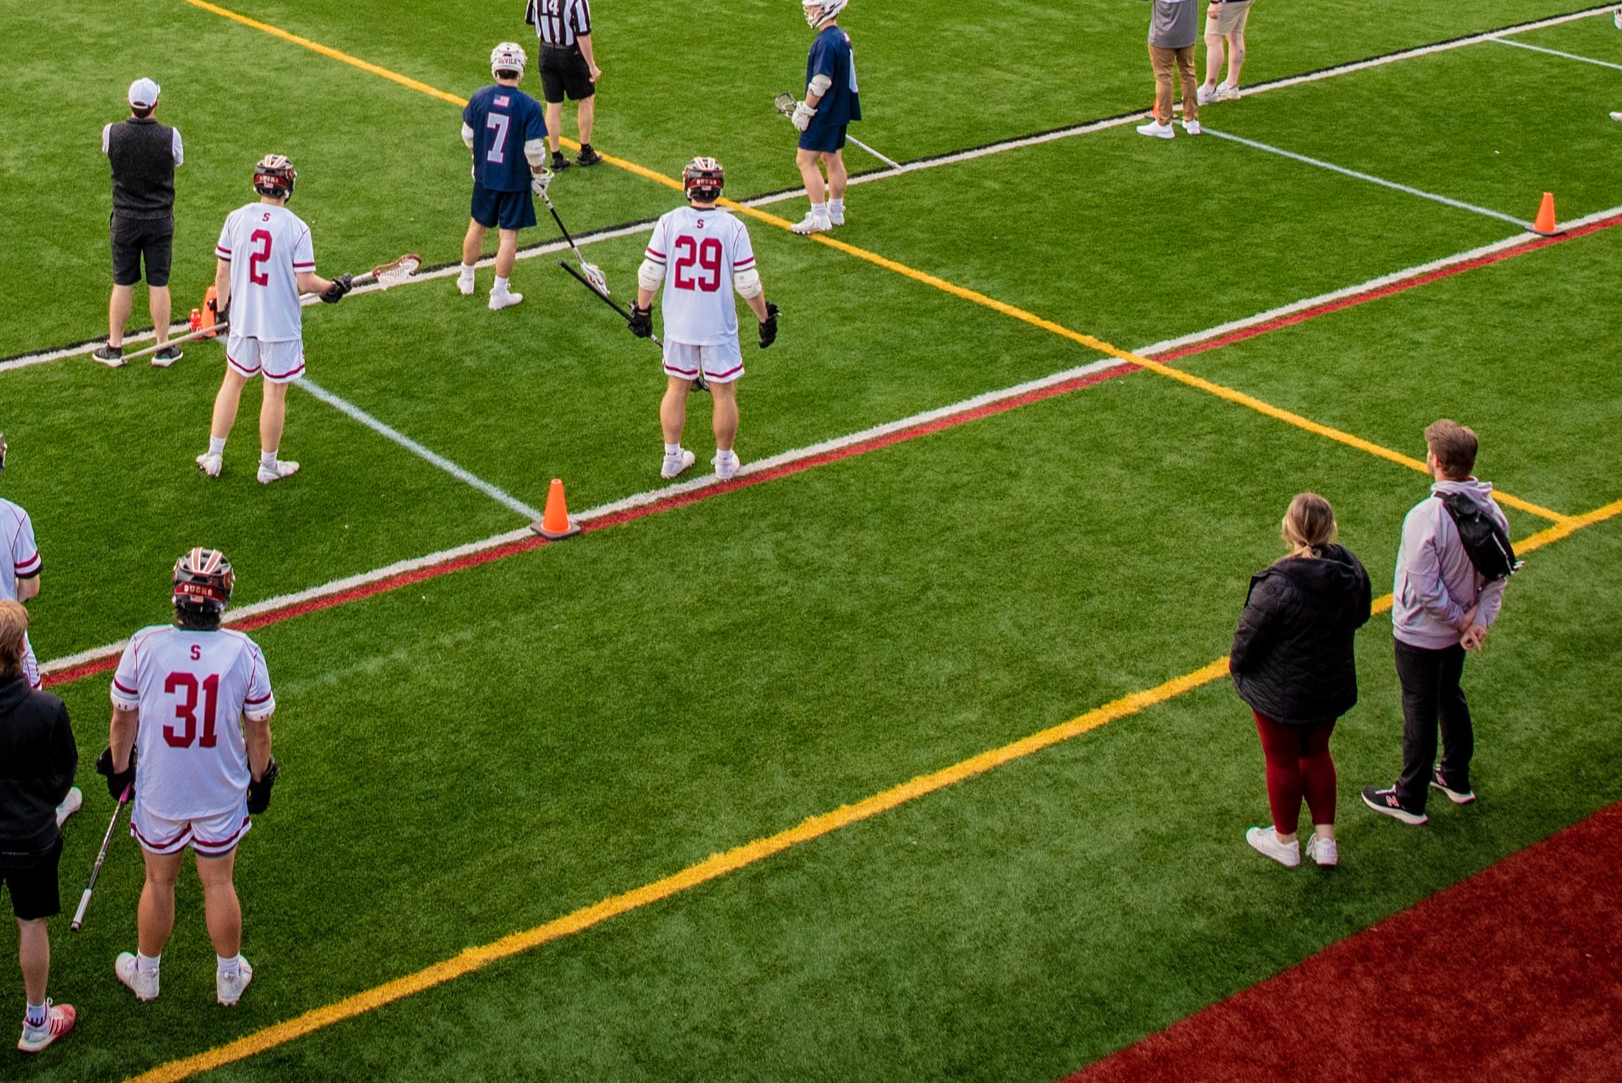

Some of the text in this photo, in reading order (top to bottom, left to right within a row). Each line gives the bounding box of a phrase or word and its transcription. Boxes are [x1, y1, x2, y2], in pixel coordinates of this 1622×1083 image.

[487, 112, 510, 164] 7
[262, 213, 271, 222] S
[697, 219, 704, 229] S
[250, 228, 273, 287] 2
[675, 235, 722, 292] 29
[184, 584, 212, 596] DUCKS
[191, 644, 201, 660] S
[163, 672, 219, 748] 31
